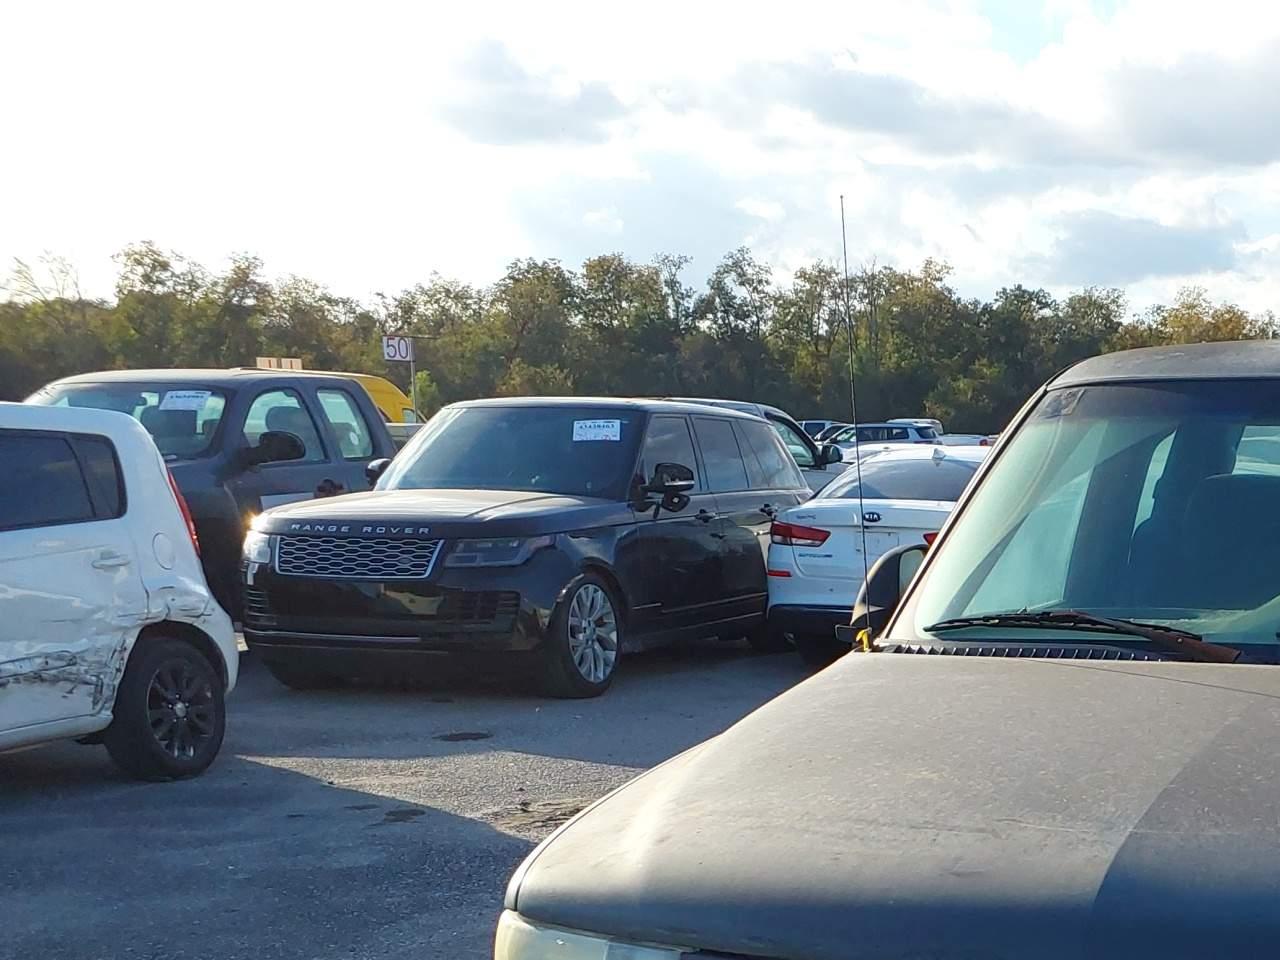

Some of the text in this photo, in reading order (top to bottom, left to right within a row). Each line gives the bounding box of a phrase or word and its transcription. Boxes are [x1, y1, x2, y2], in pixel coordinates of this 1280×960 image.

[386, 336, 409, 360] 50
[290, 523, 430, 535] RANGE ROVER
